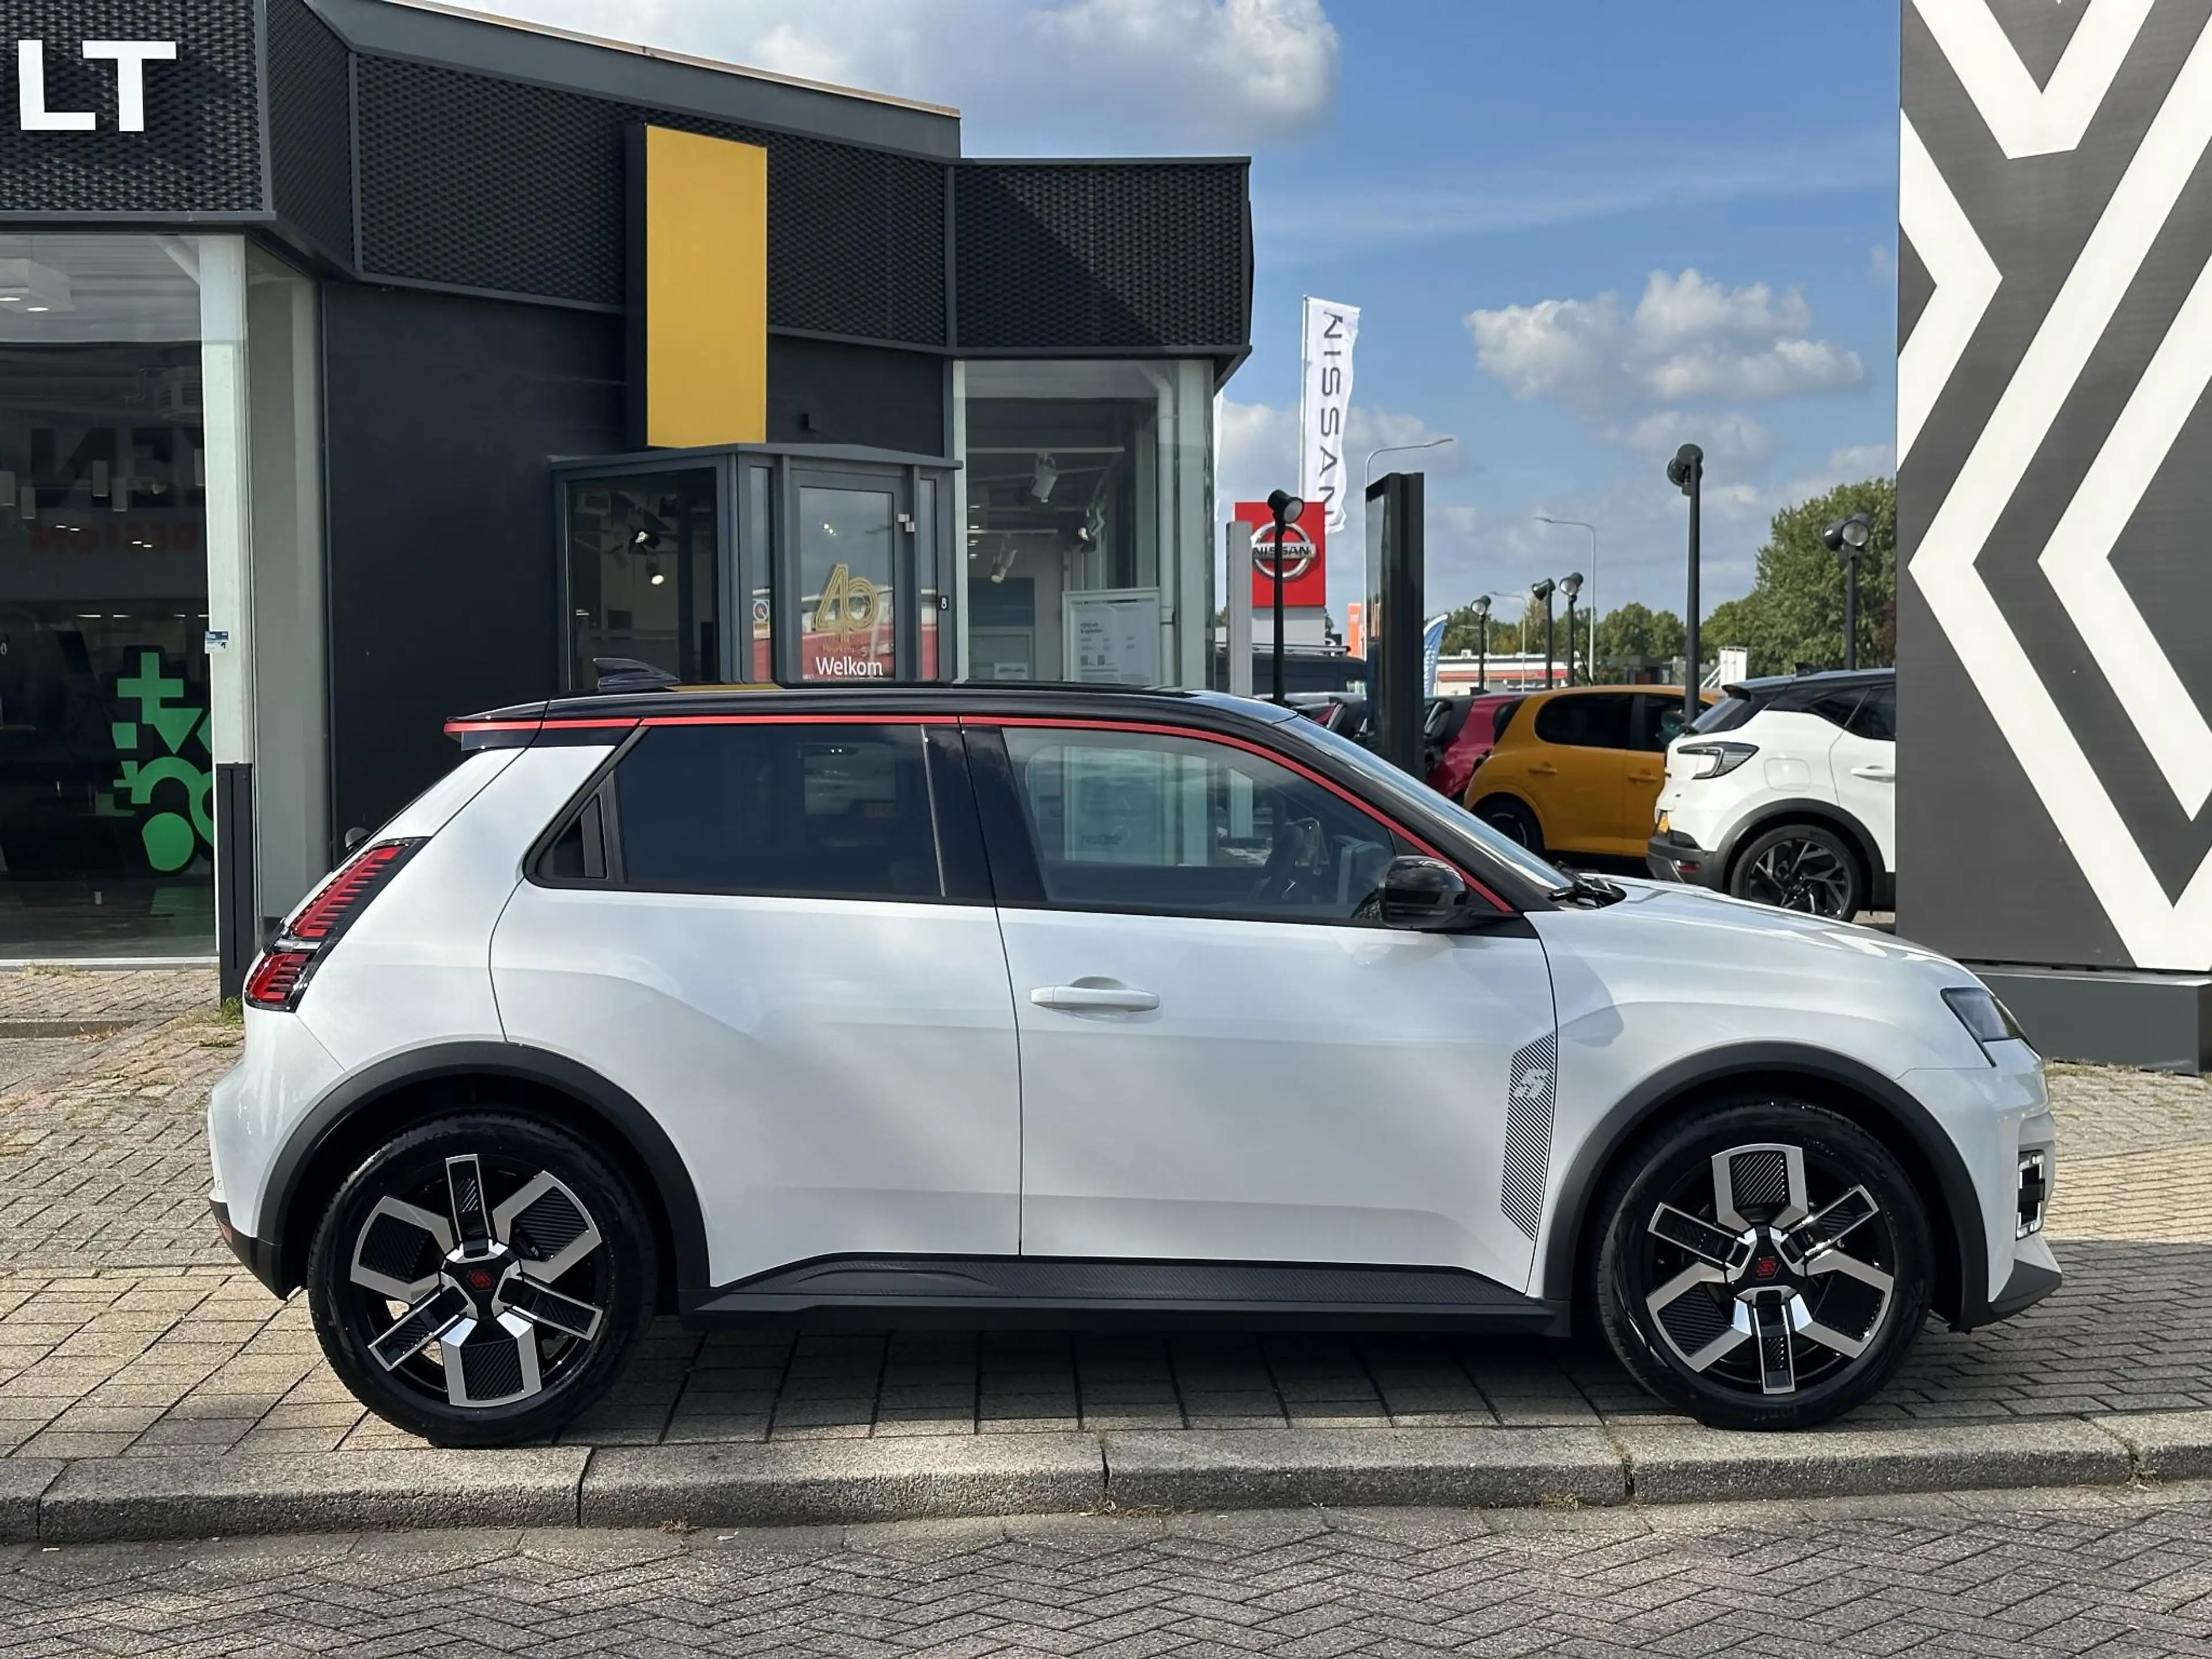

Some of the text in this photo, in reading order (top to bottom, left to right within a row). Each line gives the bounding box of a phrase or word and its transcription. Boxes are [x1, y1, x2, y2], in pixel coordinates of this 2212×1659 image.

[17, 39, 177, 132] LT
[941, 597, 947, 609] 8
[815, 656, 883, 676] Welkom
